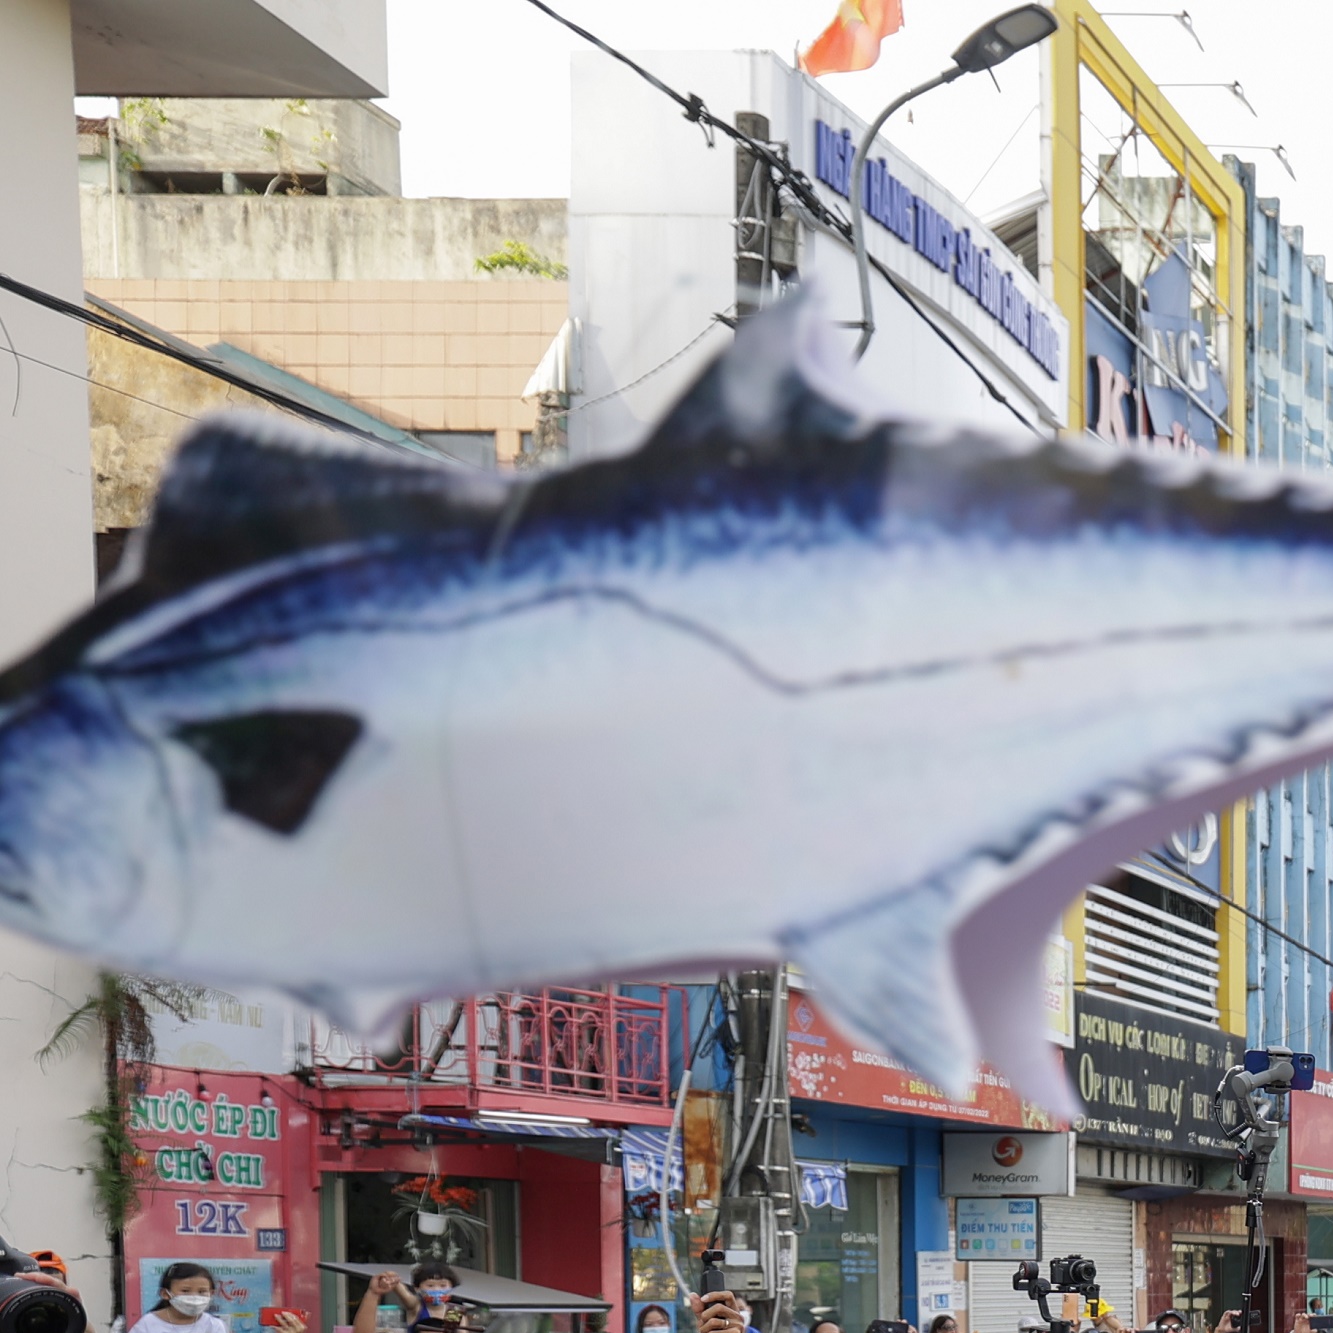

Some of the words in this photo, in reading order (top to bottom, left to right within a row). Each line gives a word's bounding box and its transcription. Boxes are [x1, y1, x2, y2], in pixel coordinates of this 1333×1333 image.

[1079, 1012, 1107, 1045] DỊCH
[1108, 1019, 1124, 1051] VỤ
[130, 1089, 207, 1133] NƯỚC
[212, 1094, 244, 1136] ÉP
[248, 1106, 279, 1139] ĐI
[218, 1153, 263, 1187] CHI
[972, 1172, 1039, 1184] MoneyGram
[176, 1201, 248, 1236] 12K
[961, 1219, 985, 1233] ĐIỂM
[988, 1223, 1008, 1233] THU
[1011, 1219, 1034, 1233] TIỀN
[259, 1232, 281, 1248] 133
